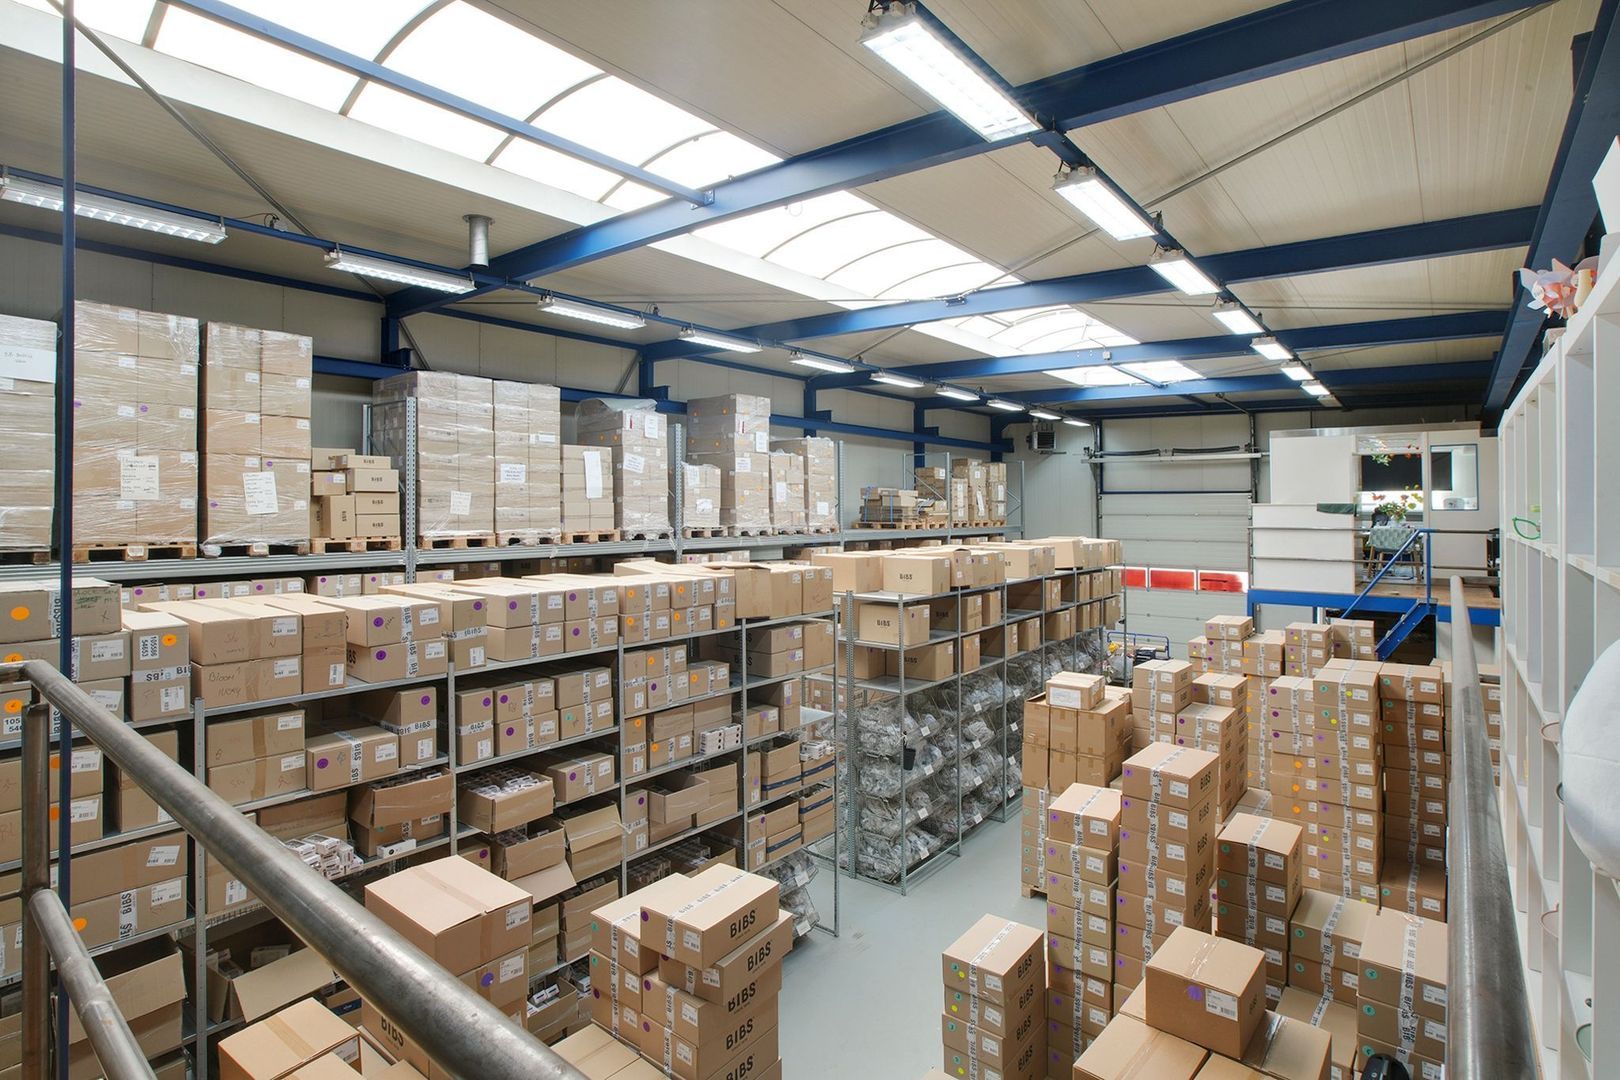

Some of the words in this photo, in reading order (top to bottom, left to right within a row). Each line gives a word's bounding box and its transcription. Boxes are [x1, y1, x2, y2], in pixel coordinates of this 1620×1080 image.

[121, 892, 132, 915] BIBS
[730, 910, 756, 938] BIBS
[747, 941, 772, 972] BIBS
[1018, 954, 1032, 978] BIBS
[728, 982, 756, 1012] BIBS
[1020, 984, 1034, 1009] BIBS
[726, 1018, 754, 1050] BIBS
[1016, 1015, 1031, 1040] BIBS
[1018, 1045, 1033, 1071] BIBS
